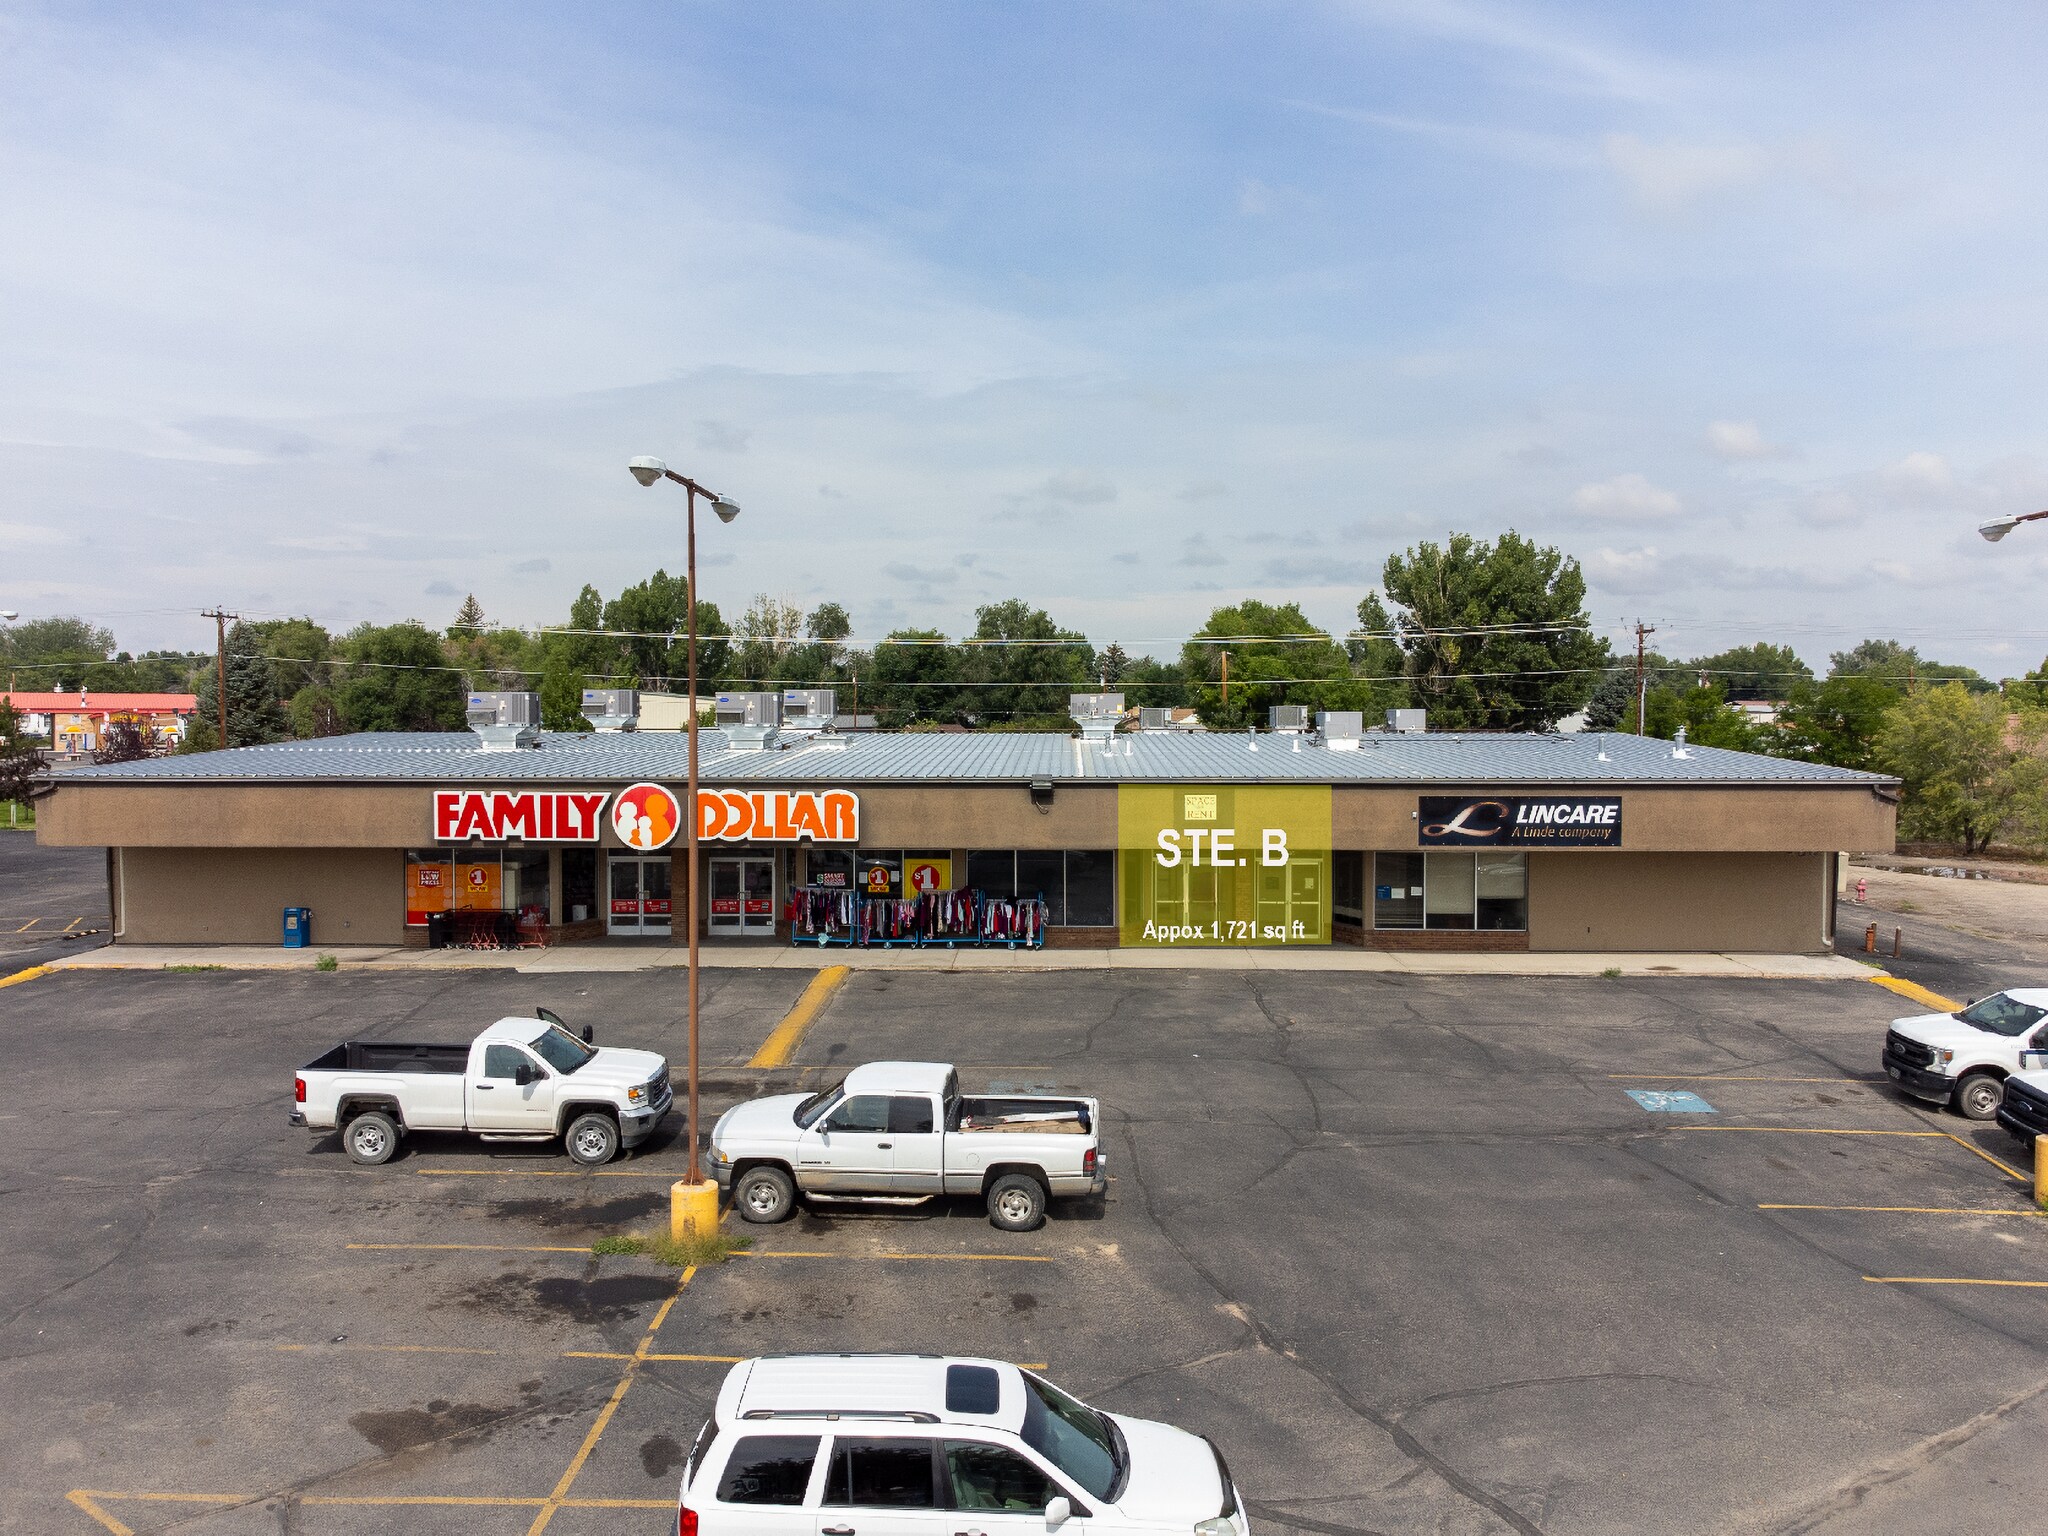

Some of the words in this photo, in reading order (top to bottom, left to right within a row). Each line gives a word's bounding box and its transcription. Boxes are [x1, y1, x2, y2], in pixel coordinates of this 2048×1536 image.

[1186, 796, 1216, 806] SPACE
[436, 793, 605, 840] FAMILY
[697, 792, 856, 840] DOLLAR
[1187, 810, 1215, 819] RENT
[1515, 804, 1620, 824] LINCARE
[1511, 826, 1521, 838] A
[1523, 826, 1555, 838] Linde
[1558, 827, 1613, 840] company
